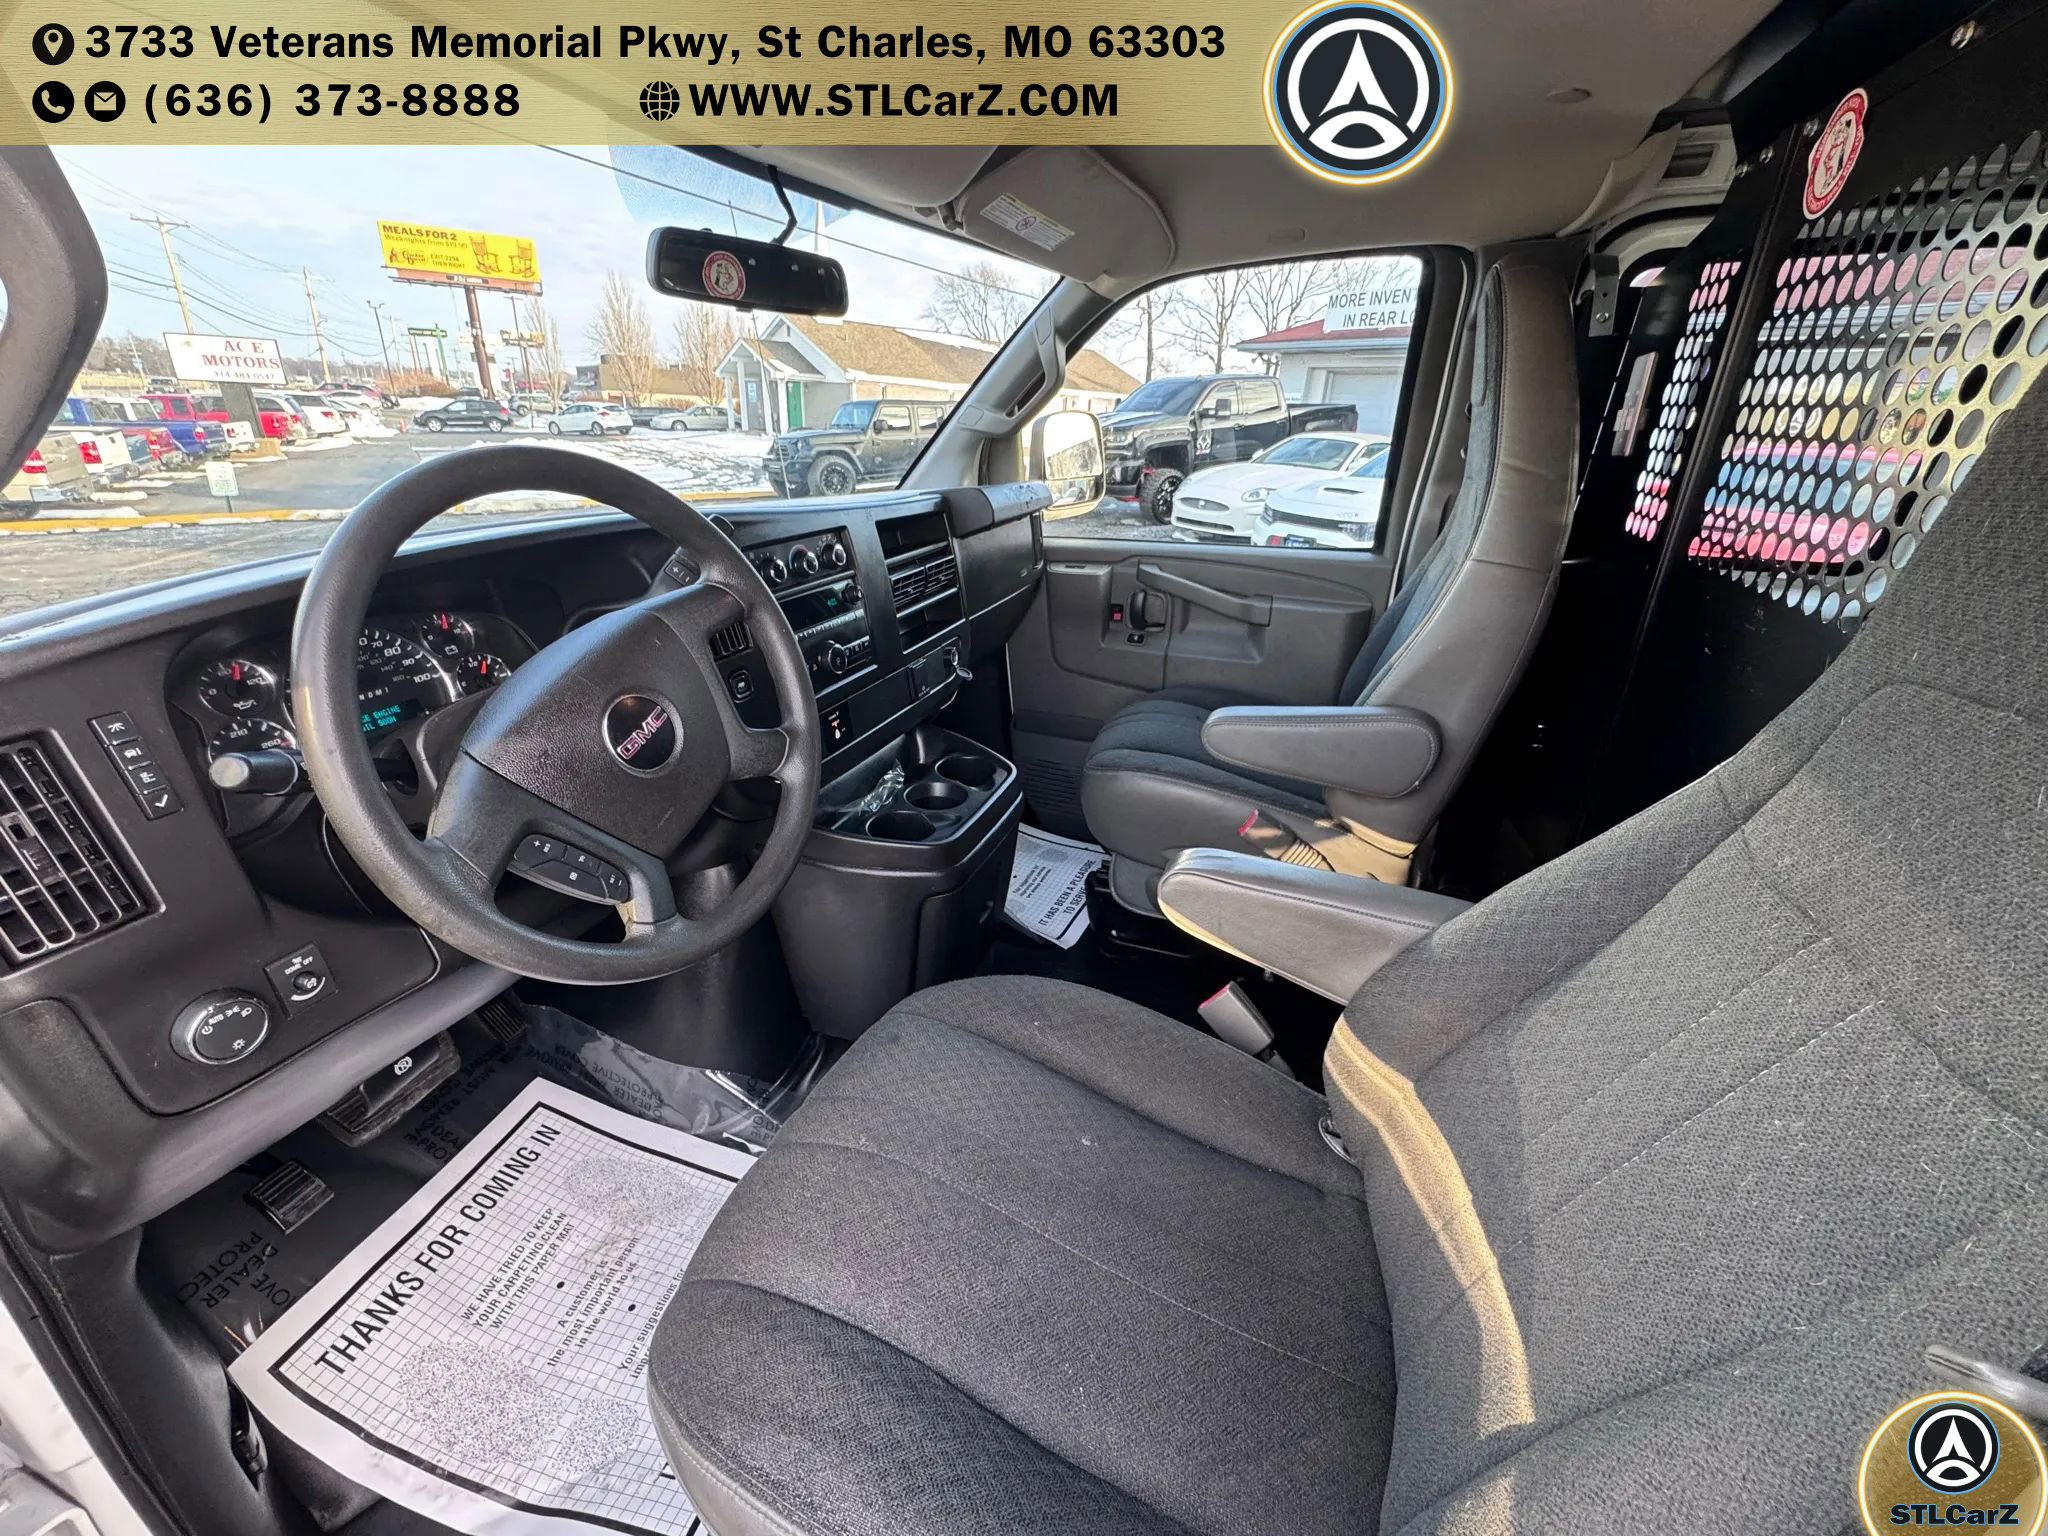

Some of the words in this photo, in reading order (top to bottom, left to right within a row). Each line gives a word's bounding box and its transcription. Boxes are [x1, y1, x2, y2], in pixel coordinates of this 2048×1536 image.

[382, 224, 424, 237] MEALS
[425, 229, 448, 240] FOR
[449, 233, 458, 241] 2
[1328, 292, 1367, 309] MORE
[1342, 313, 1356, 328] IN
[1358, 311, 1397, 327] REAR
[224, 340, 264, 353] ACE
[201, 354, 280, 369] MOTORS
[370, 640, 383, 649] 70
[383, 646, 402, 657] 80
[401, 657, 415, 667] 90
[413, 672, 431, 683] 100
[372, 704, 401, 719] ENGINE
[377, 715, 397, 727] SOON
[616, 705, 668, 760] GMC
[1054, 891, 1071, 907] BEEN
[1043, 906, 1060, 920] HAS
[1063, 905, 1076, 915] TO
[1038, 918, 1049, 926] IT
[208, 1014, 225, 1026] AUTO
[313, 1270, 425, 1375] THANKS
[414, 1224, 470, 1273] FOR
[460, 1146, 542, 1223] COMING
[530, 1124, 561, 1147] IN
[461, 1302, 480, 1320] WE
[476, 1275, 502, 1303] HAVE
[498, 1244, 526, 1275] TRIED
[522, 1231, 537, 1244] TO
[533, 1207, 554, 1231] KEEP
[472, 1299, 502, 1328] YOUR
[497, 1242, 544, 1298] CARPETING
[541, 1212, 568, 1242] CLEAN
[203, 1242, 279, 1308] DEALER
[489, 1300, 517, 1329] WITH
[511, 1275, 536, 1300] THIS
[531, 1242, 560, 1275] PAPER
[556, 1221, 575, 1242] MAT
[547, 1348, 565, 1367] the
[562, 1318, 582, 1347] most
[581, 1268, 618, 1317] important
[615, 1236, 639, 1267] person
[558, 1319, 568, 1328] A
[565, 1269, 601, 1318] customer
[596, 1260, 608, 1269] is
[574, 1337, 588, 1349] in
[584, 1317, 600, 1335] the
[598, 1286, 621, 1316] world
[616, 1274, 629, 1285] to
[619, 1343, 640, 1370] Your
[637, 1282, 678, 1343] suggestions
[673, 1268, 686, 1282] for
